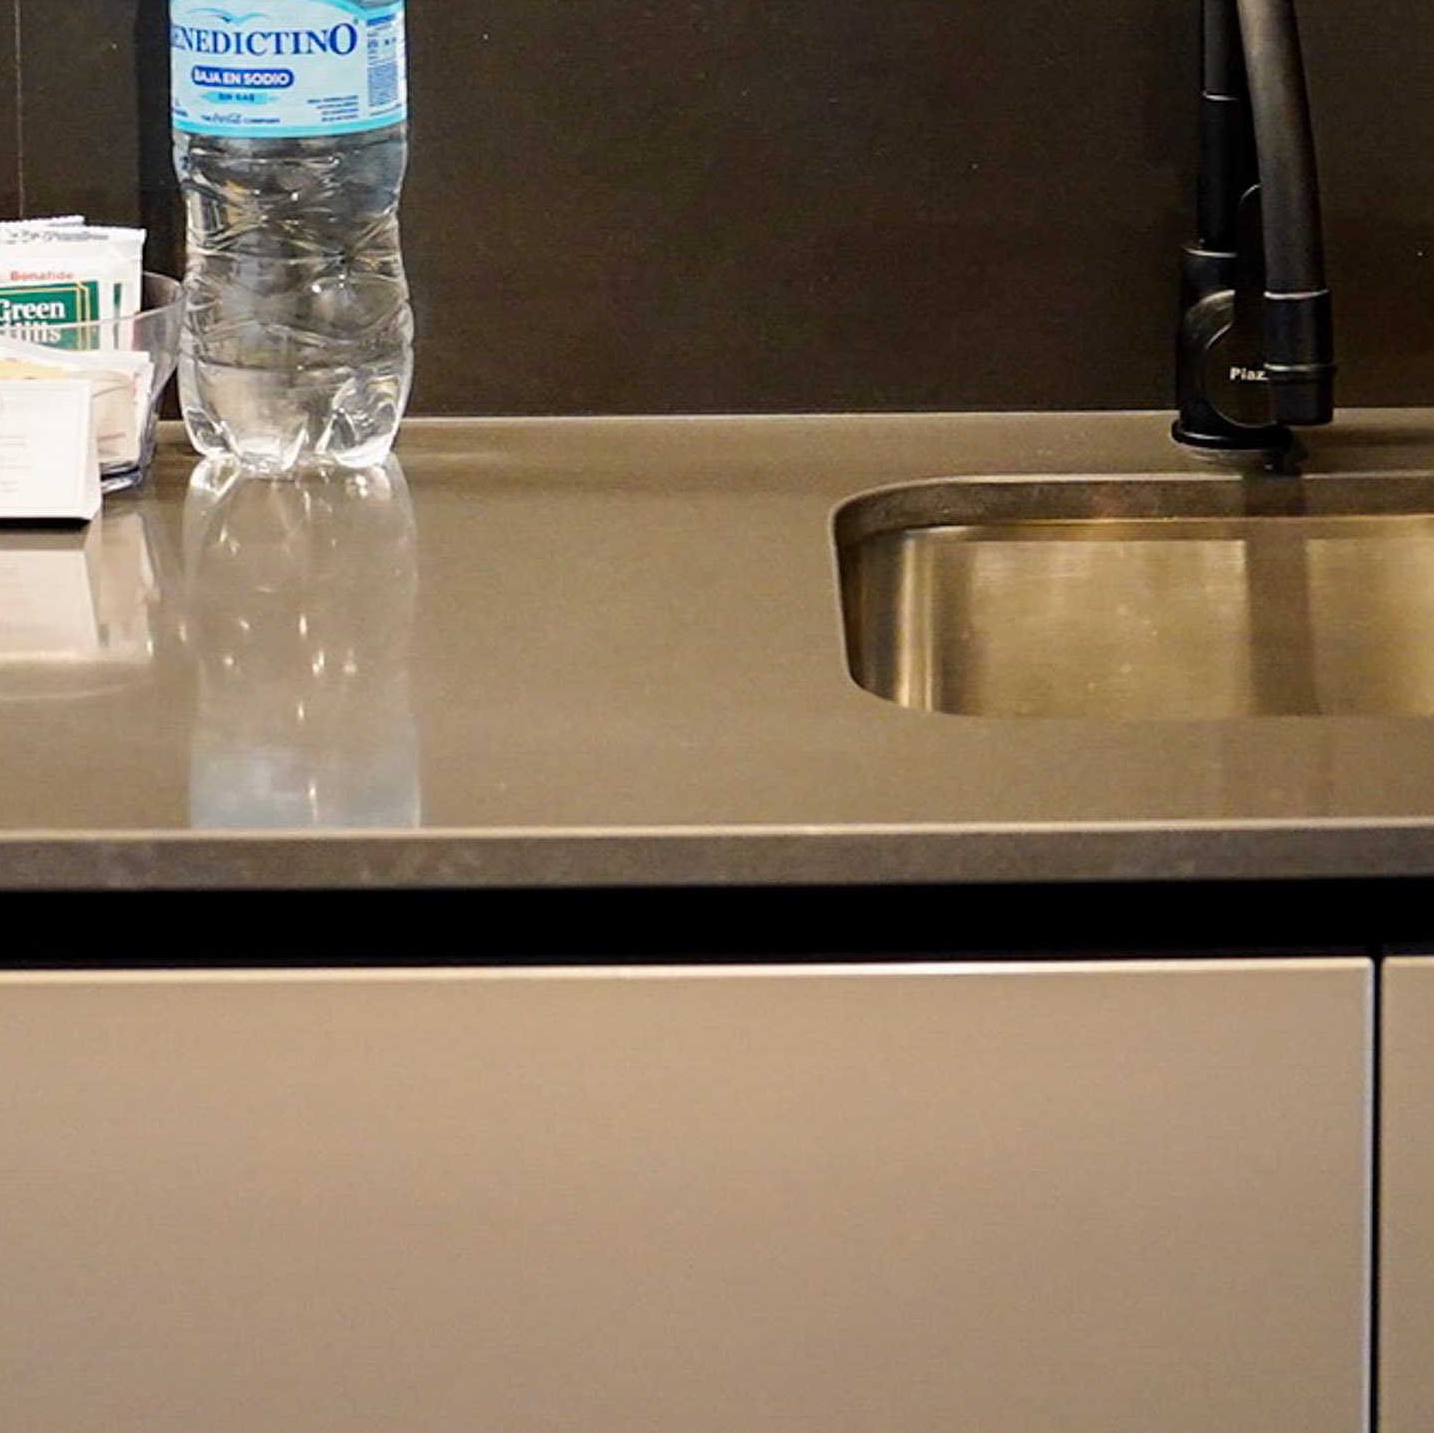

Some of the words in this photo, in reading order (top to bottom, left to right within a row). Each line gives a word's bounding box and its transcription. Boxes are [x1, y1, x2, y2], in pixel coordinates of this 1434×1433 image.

[171, 22, 358, 56] ENEDICTINO
[223, 71, 241, 85] EN
[243, 72, 289, 86] SODIO
